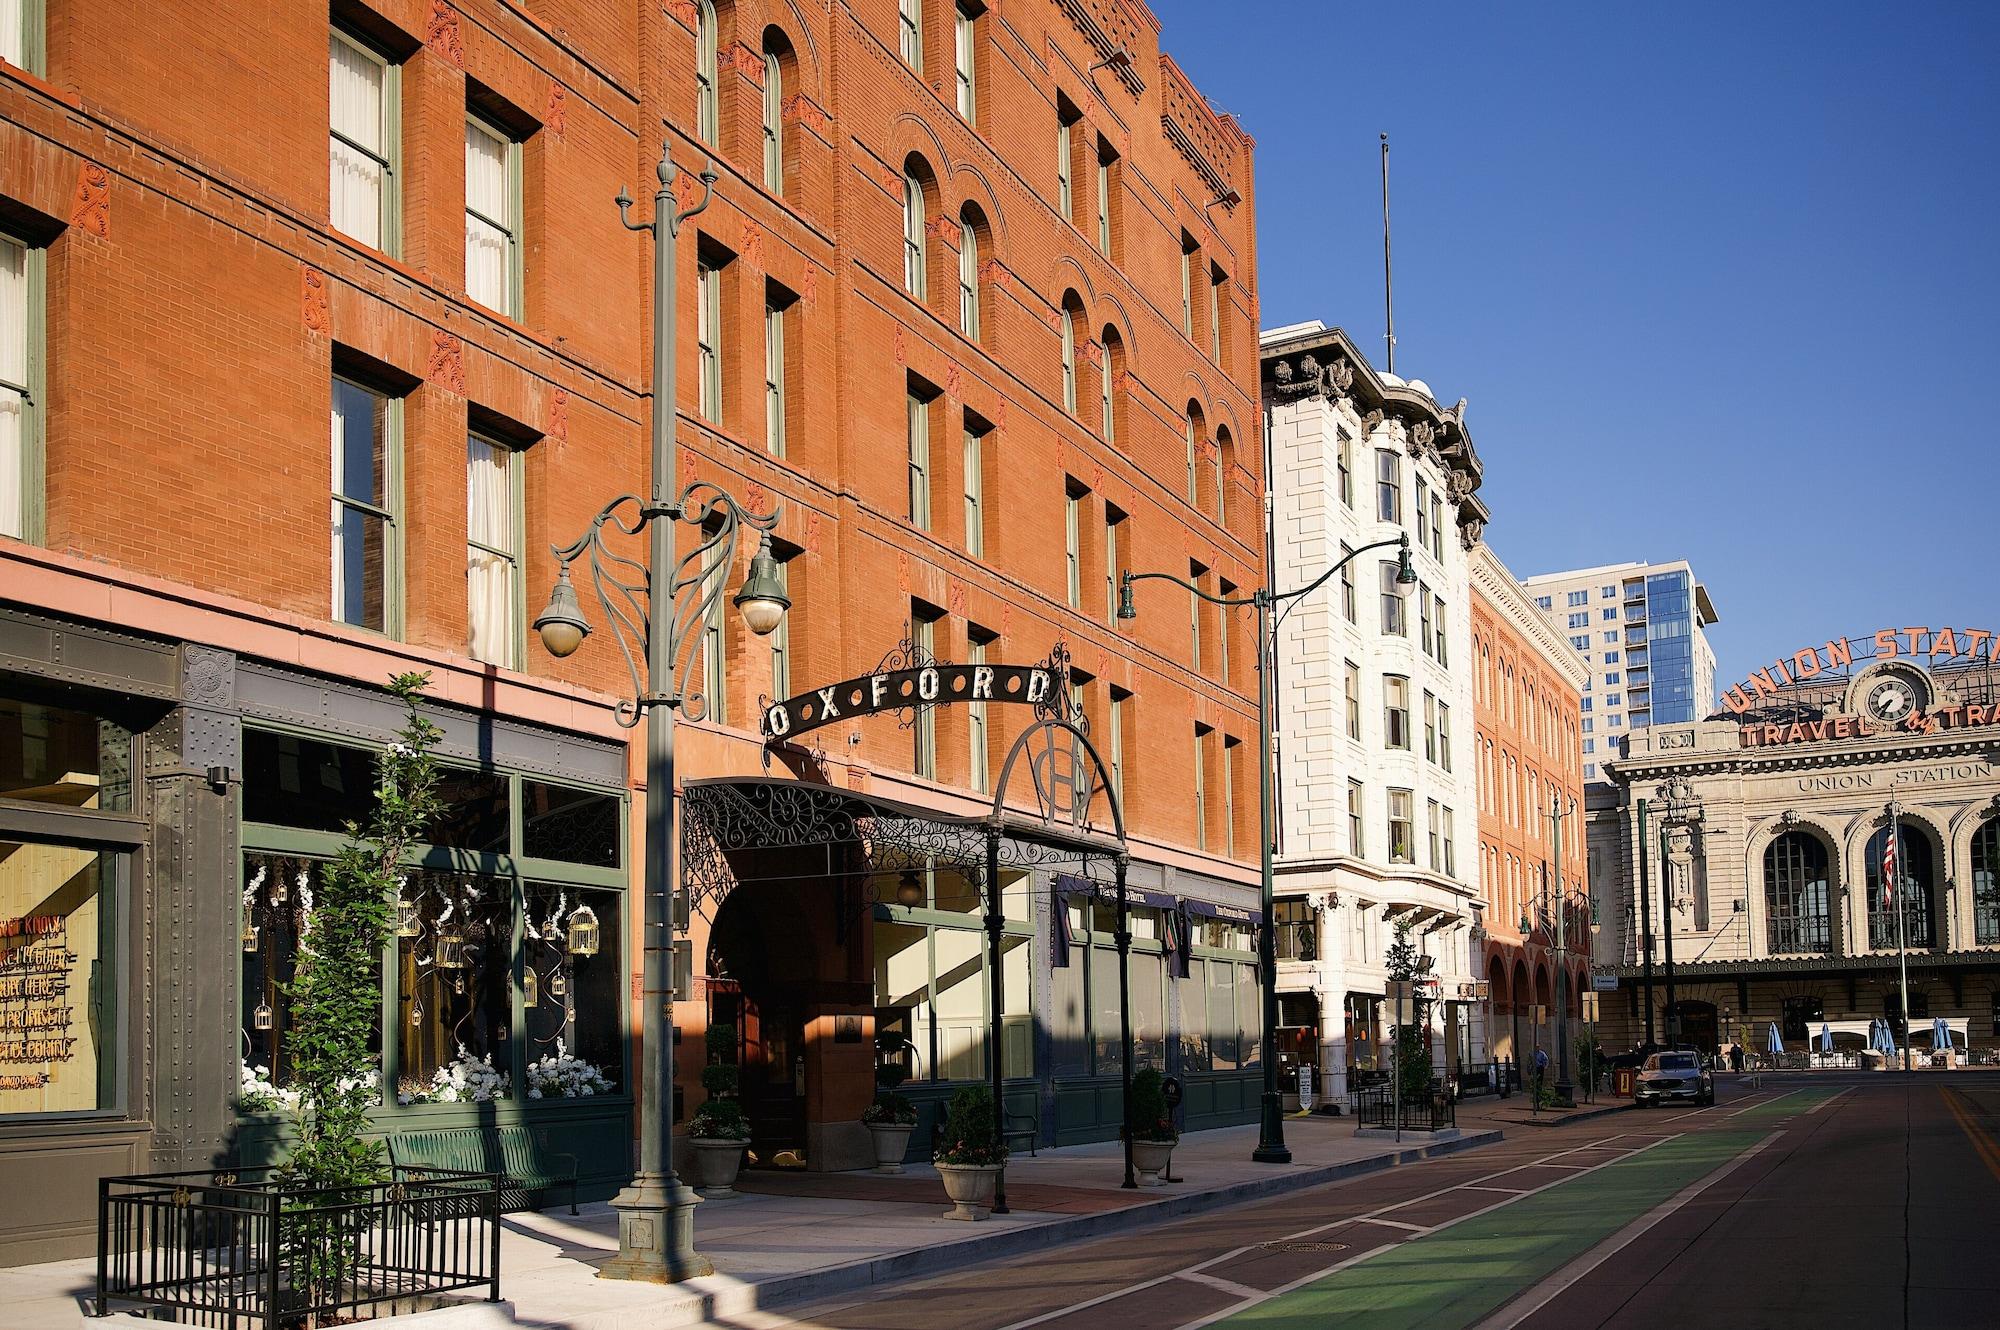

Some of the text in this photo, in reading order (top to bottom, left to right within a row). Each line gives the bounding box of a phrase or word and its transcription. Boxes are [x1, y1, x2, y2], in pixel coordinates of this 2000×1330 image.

[768, 666, 1051, 736] OXFORD
[1721, 636, 1852, 714] UNION
[1741, 716, 1876, 746] TRAVEL
[1905, 709, 1936, 736] by
[1799, 763, 1992, 792] UNION STATION
